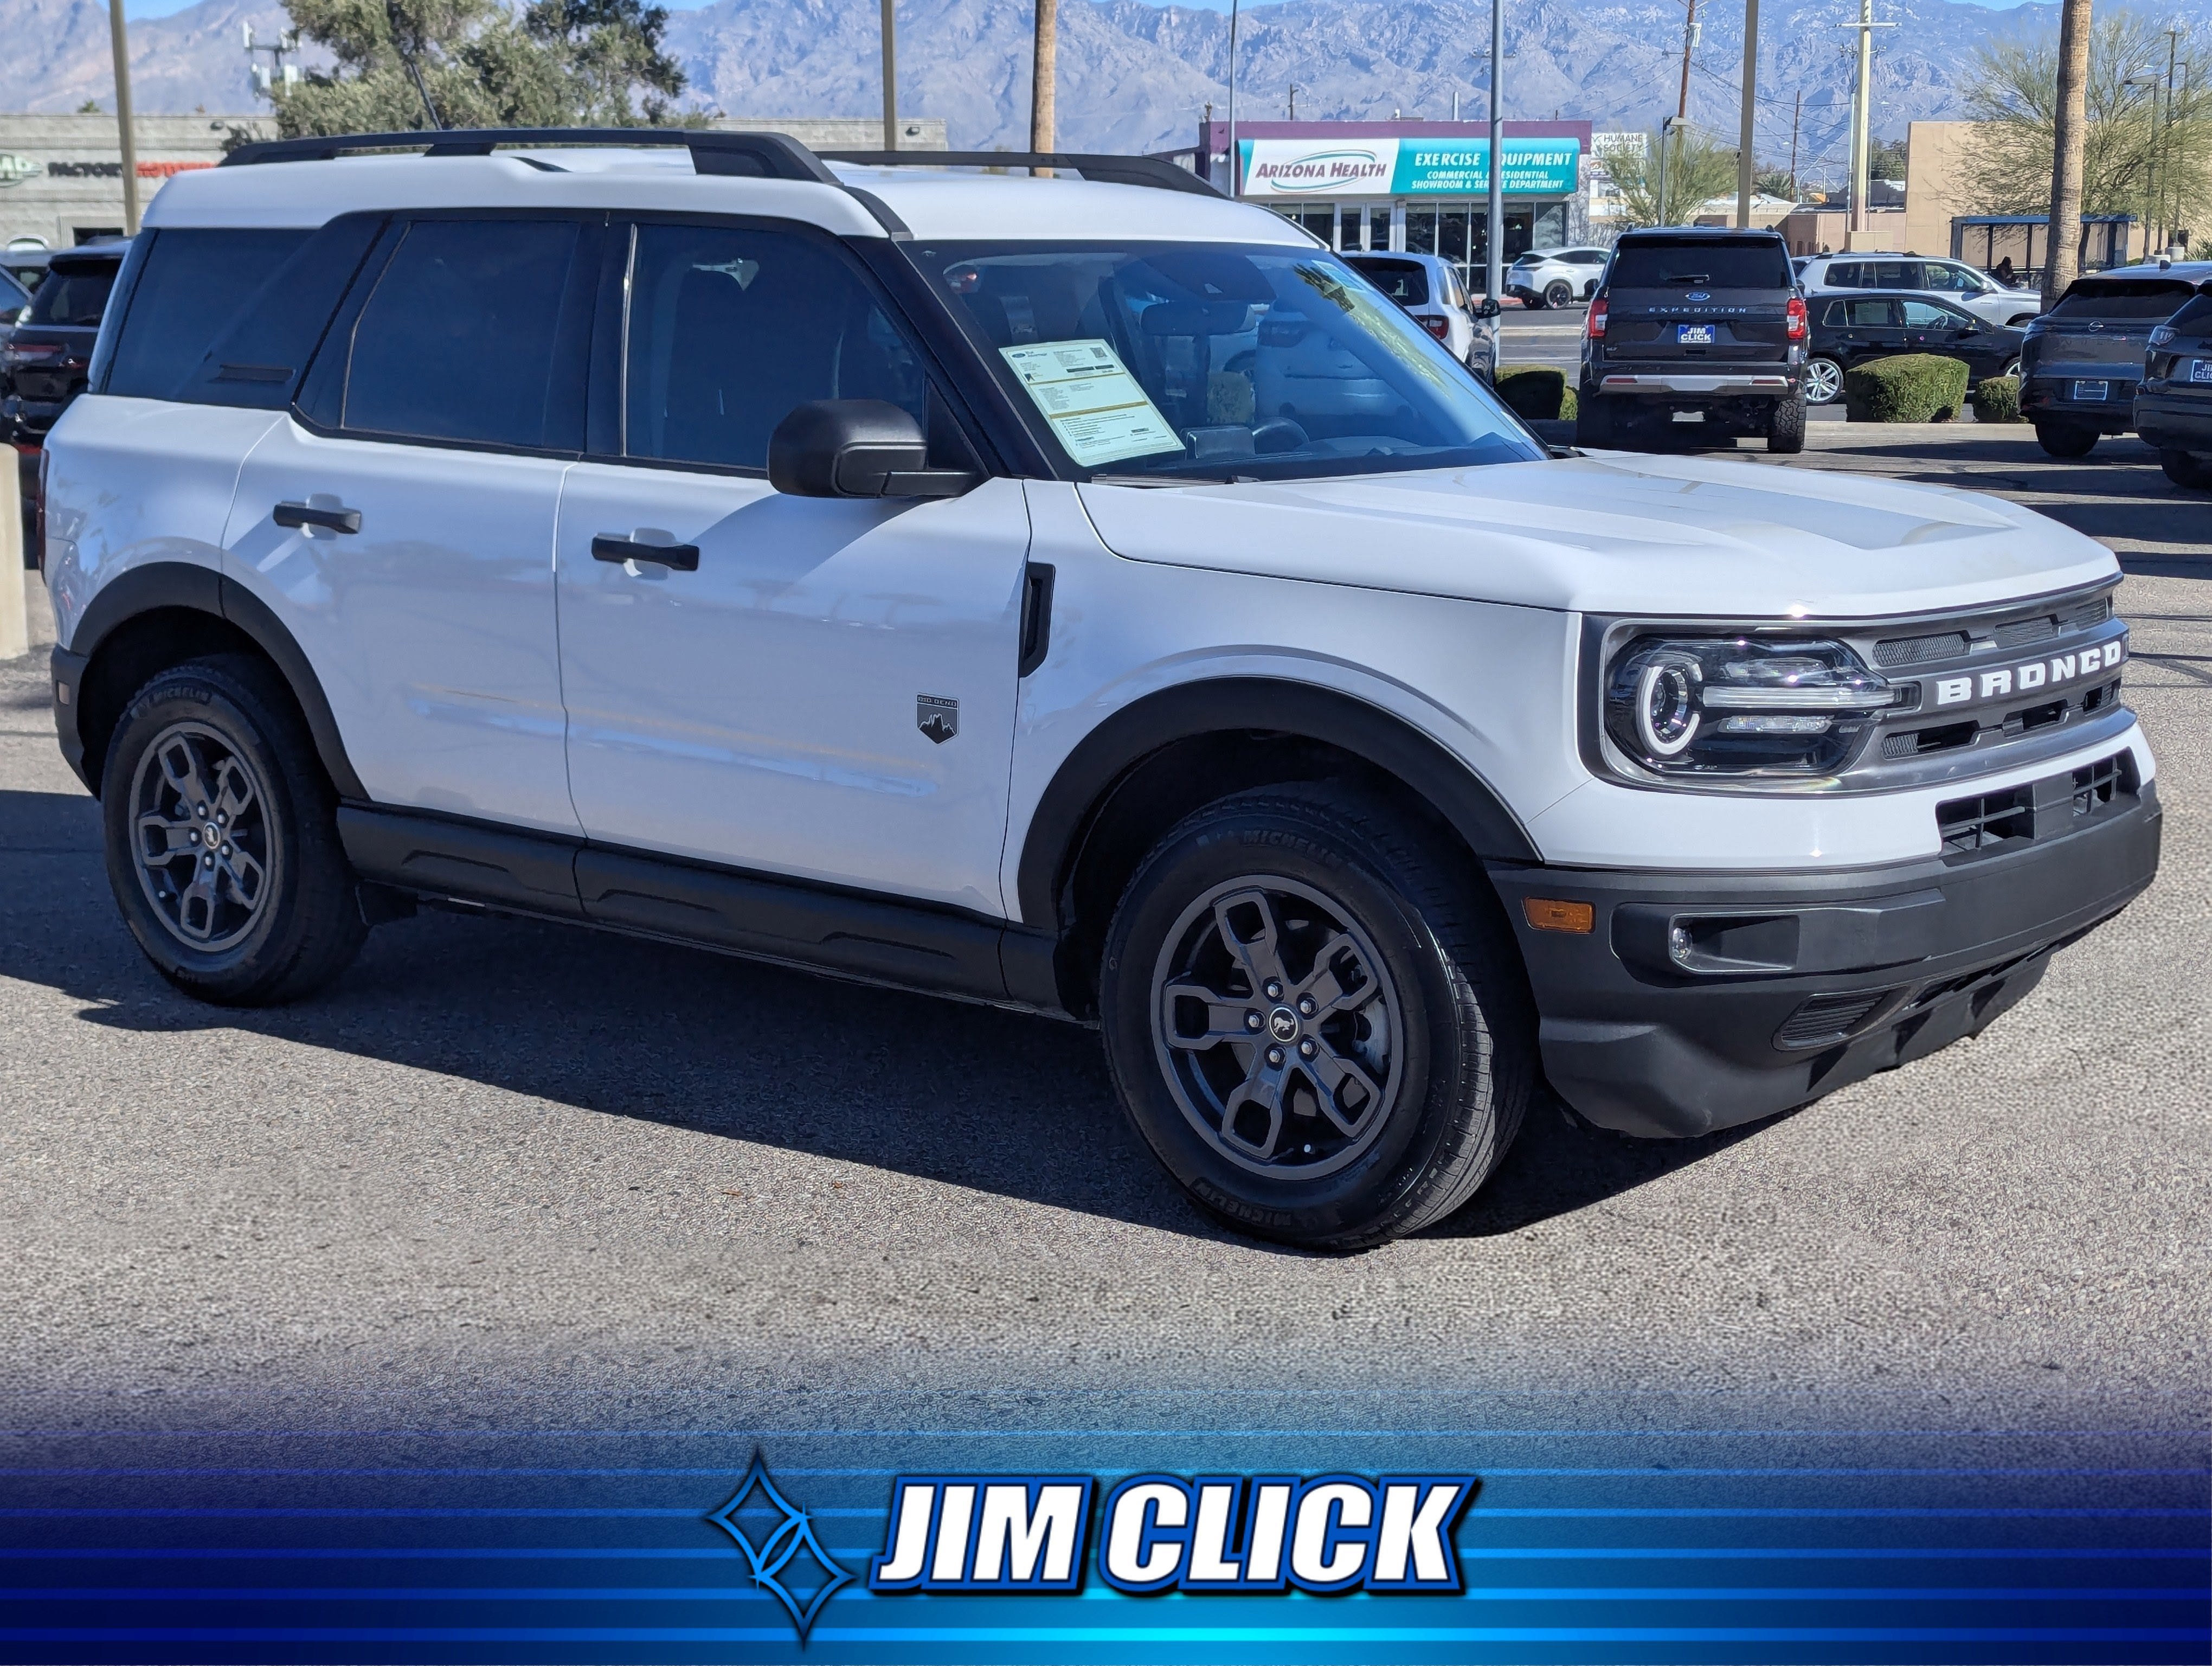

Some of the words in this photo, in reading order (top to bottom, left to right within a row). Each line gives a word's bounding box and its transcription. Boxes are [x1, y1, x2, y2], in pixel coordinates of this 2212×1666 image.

[1604, 134, 1643, 142] HUMANE
[1414, 153, 1481, 166] EXERCISE
[1501, 152, 1572, 166] QUIPMENT
[1255, 163, 1325, 178] ARIZONA
[1329, 162, 1387, 177] HEALTH
[1426, 170, 1483, 180] COMMERCIAL
[1501, 170, 1549, 180] ESIDENTIAL
[1411, 180, 1463, 189] SHOWROOM
[1465, 180, 1472, 189] &
[1509, 180, 1564, 189] DEPARTMENT
[1936, 640, 2121, 705] BRONCO
